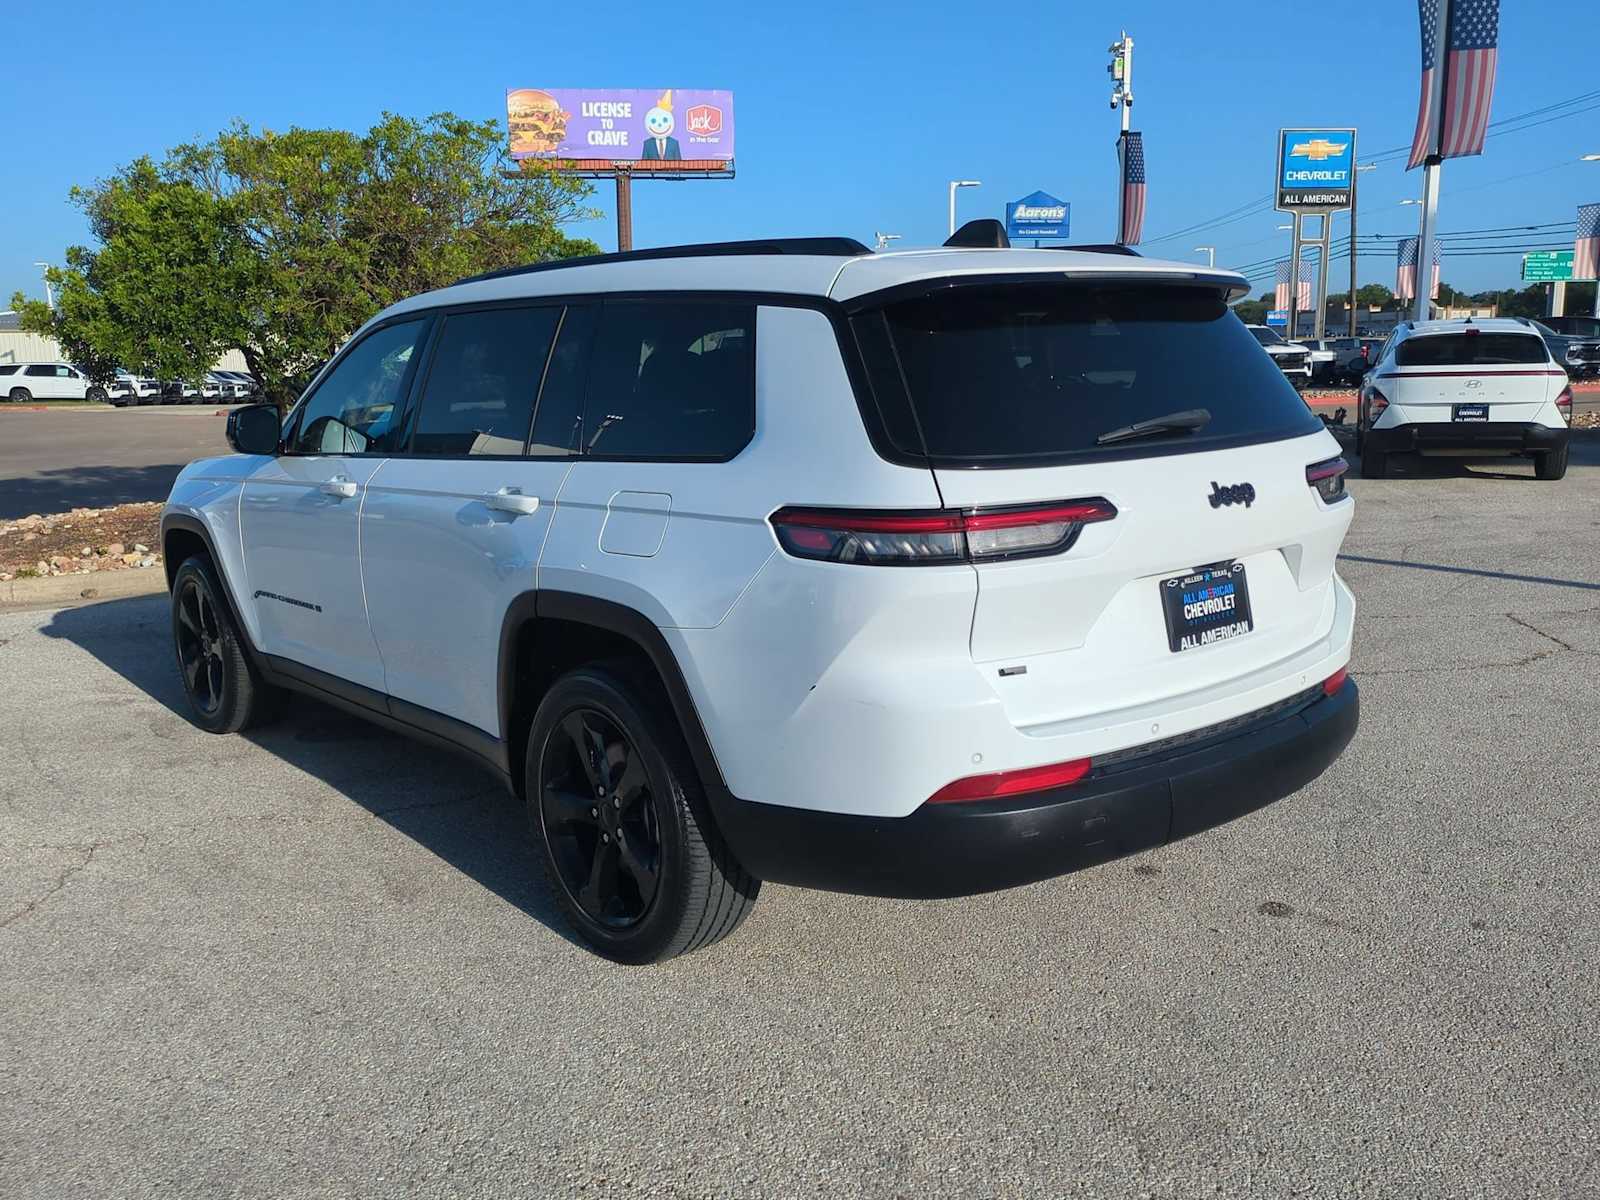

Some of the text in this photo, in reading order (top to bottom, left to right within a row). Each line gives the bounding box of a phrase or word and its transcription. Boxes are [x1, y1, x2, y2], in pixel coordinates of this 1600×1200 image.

[582, 102, 631, 118] LICENSE
[601, 118, 613, 130] TO
[688, 108, 720, 130] Jack
[587, 130, 629, 146] CRAVE
[1286, 170, 1347, 181] CHEVROLET
[1284, 194, 1347, 204] ALL AMERICAN
[1014, 204, 1066, 219] Aaron's
[1208, 481, 1256, 509] Jeep
[1211, 569, 1228, 578] TEXAS
[1183, 583, 1234, 605] ALL AMERICAN
[1184, 594, 1236, 620] CHEVROLET
[1181, 620, 1249, 651] ALL AMERICAN
